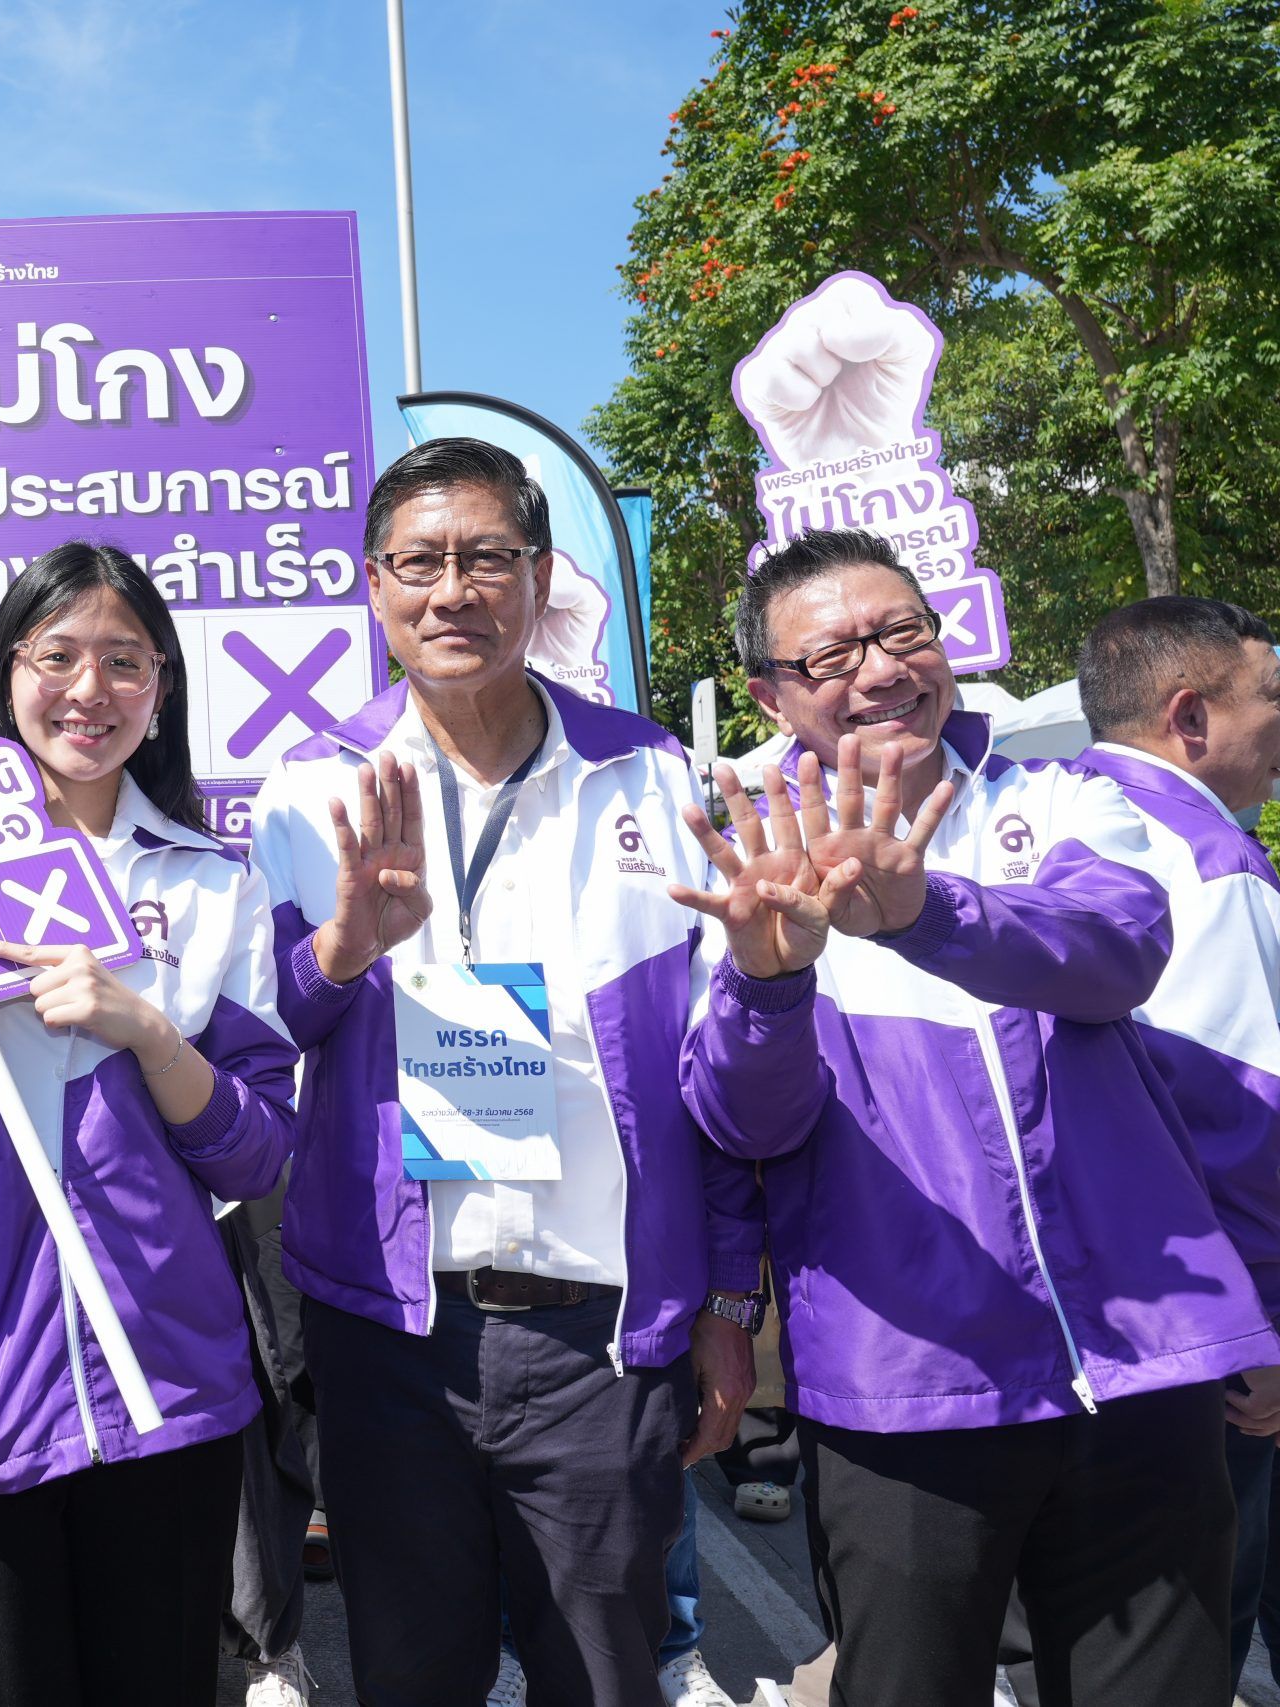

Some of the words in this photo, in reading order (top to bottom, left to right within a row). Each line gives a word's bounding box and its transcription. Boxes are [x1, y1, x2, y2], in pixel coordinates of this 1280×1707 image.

[765, 440, 929, 491] พรรคไทยสร้างไทย
[772, 479, 936, 538] ไม่โกง
[436, 1030, 508, 1047] พรรค
[403, 1056, 546, 1078] ไทยสร้างไทย
[462, 1109, 483, 1117] 28-31
[514, 1108, 534, 1116] 2568
